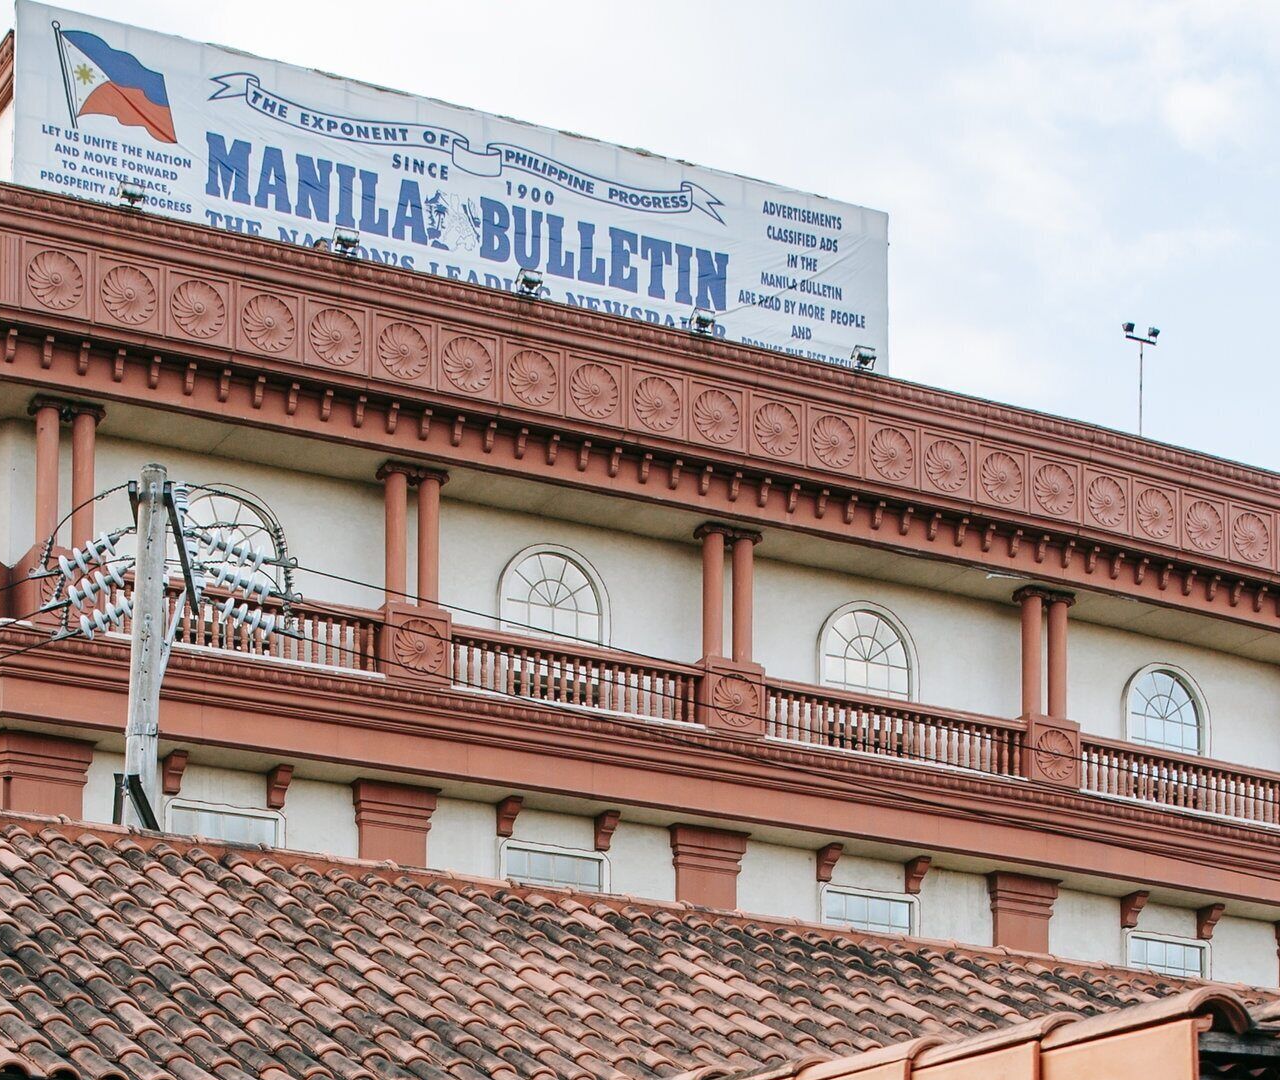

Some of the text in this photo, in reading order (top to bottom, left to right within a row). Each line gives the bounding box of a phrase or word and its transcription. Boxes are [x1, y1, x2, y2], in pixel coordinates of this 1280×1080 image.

[251, 90, 449, 147] THE EXPONENT OF
[42, 124, 192, 169] LET US UNITE THE NATION
[54, 143, 178, 181] AND MOVE FORWARD
[61, 160, 77, 171] TO
[81, 165, 129, 183] ACHIEVE
[391, 153, 449, 181] SINCE
[505, 150, 689, 210] PHILIPPINE PROGRESS
[40, 170, 192, 214] PROSPERITY ROGRESS
[205, 131, 429, 246] MANILA
[505, 181, 555, 205] 1900
[762, 200, 842, 231] ADVERTISEMENTS
[479, 196, 730, 312] BULLETIN
[766, 225, 839, 253] CLASSIFIED ADS
[429, 261, 552, 301] LEADIG
[787, 253, 818, 272] IN THE
[760, 271, 842, 301] MANILA BULLETIN
[738, 289, 866, 329] ARE READ BY MORE PEOPLE
[791, 325, 812, 341] AND
